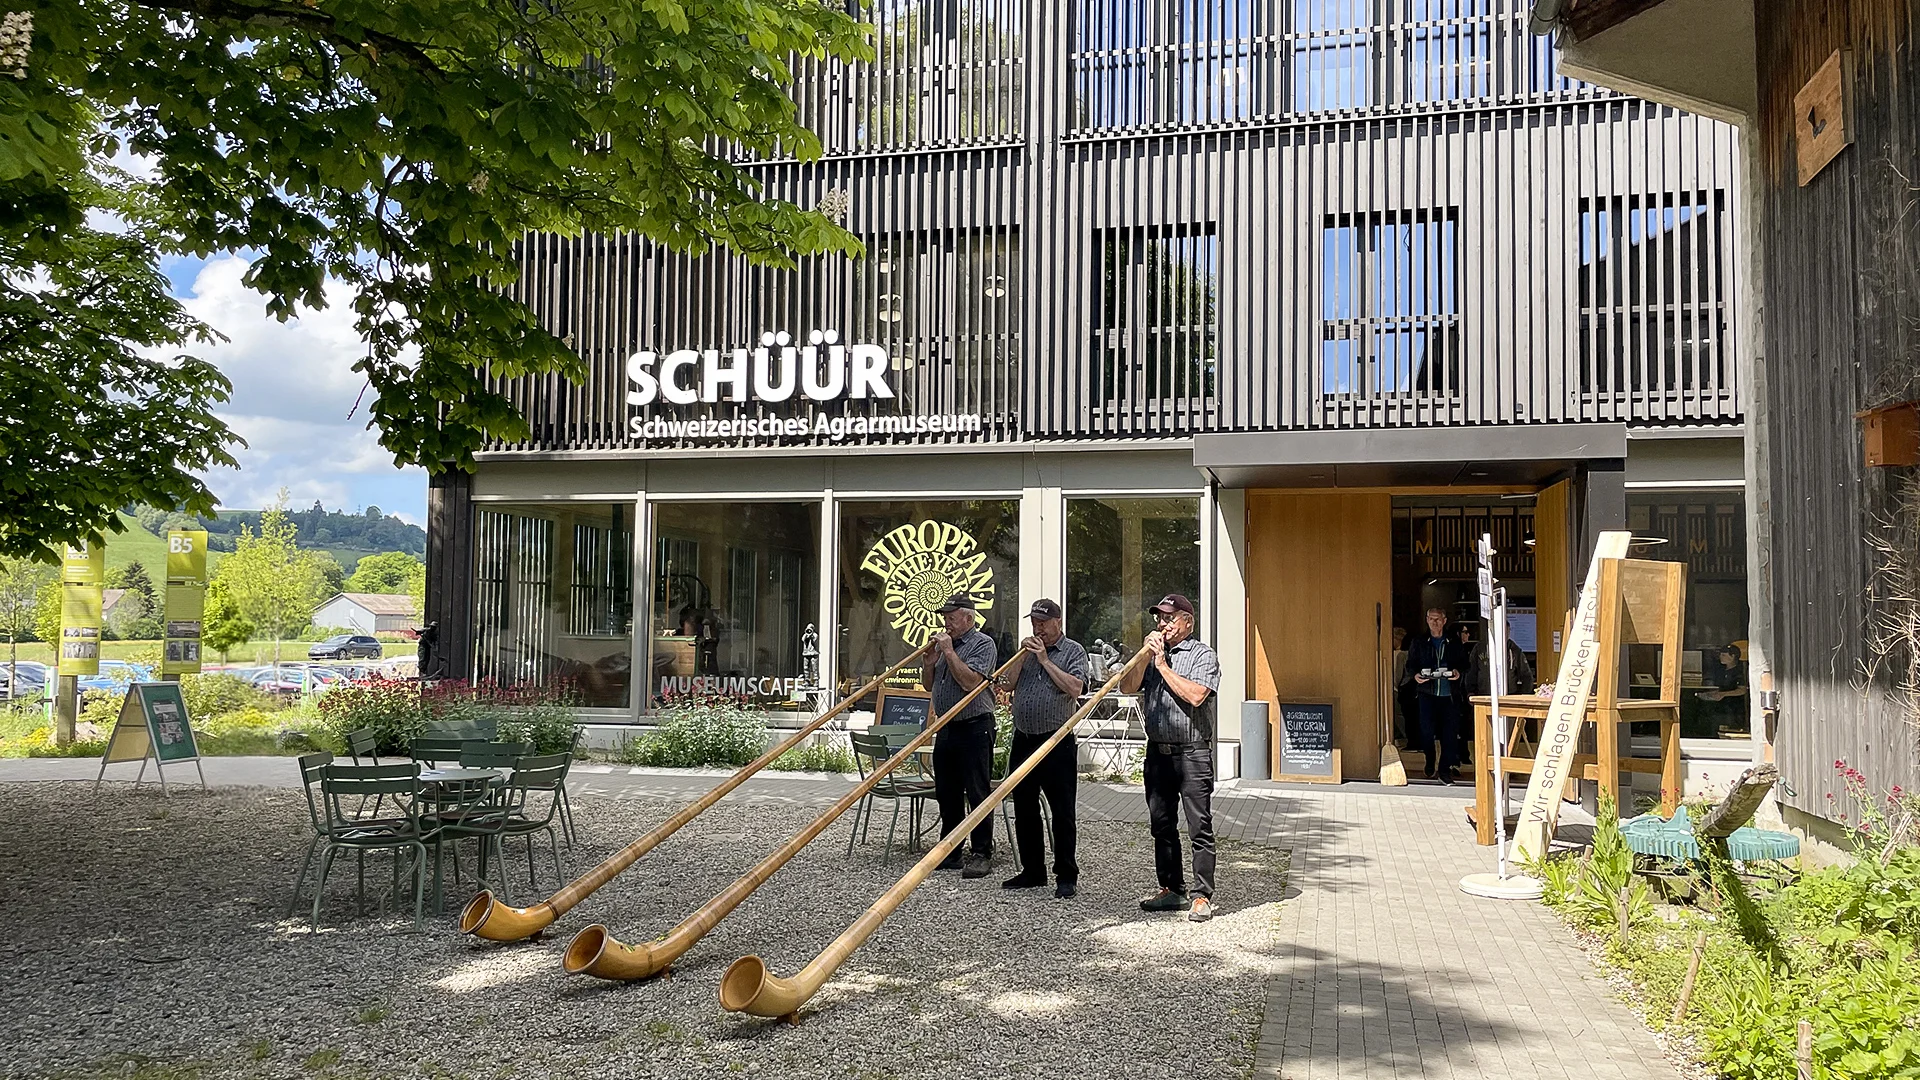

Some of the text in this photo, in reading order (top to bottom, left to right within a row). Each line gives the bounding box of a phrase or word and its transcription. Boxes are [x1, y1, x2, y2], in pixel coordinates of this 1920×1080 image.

[626, 329, 896, 405] SCHÜÜR
[629, 412, 981, 441] Schweizerisches Agrarmuseum
[170, 536, 193, 554] B5
[860, 519, 995, 595] EUROPEAN
[890, 552, 931, 585] THE
[932, 552, 969, 595] YEAR
[883, 581, 907, 614] OF
[1529, 792, 1549, 823] Wir
[1542, 711, 1573, 790] schlagen
[1560, 638, 1594, 706] Brücken
